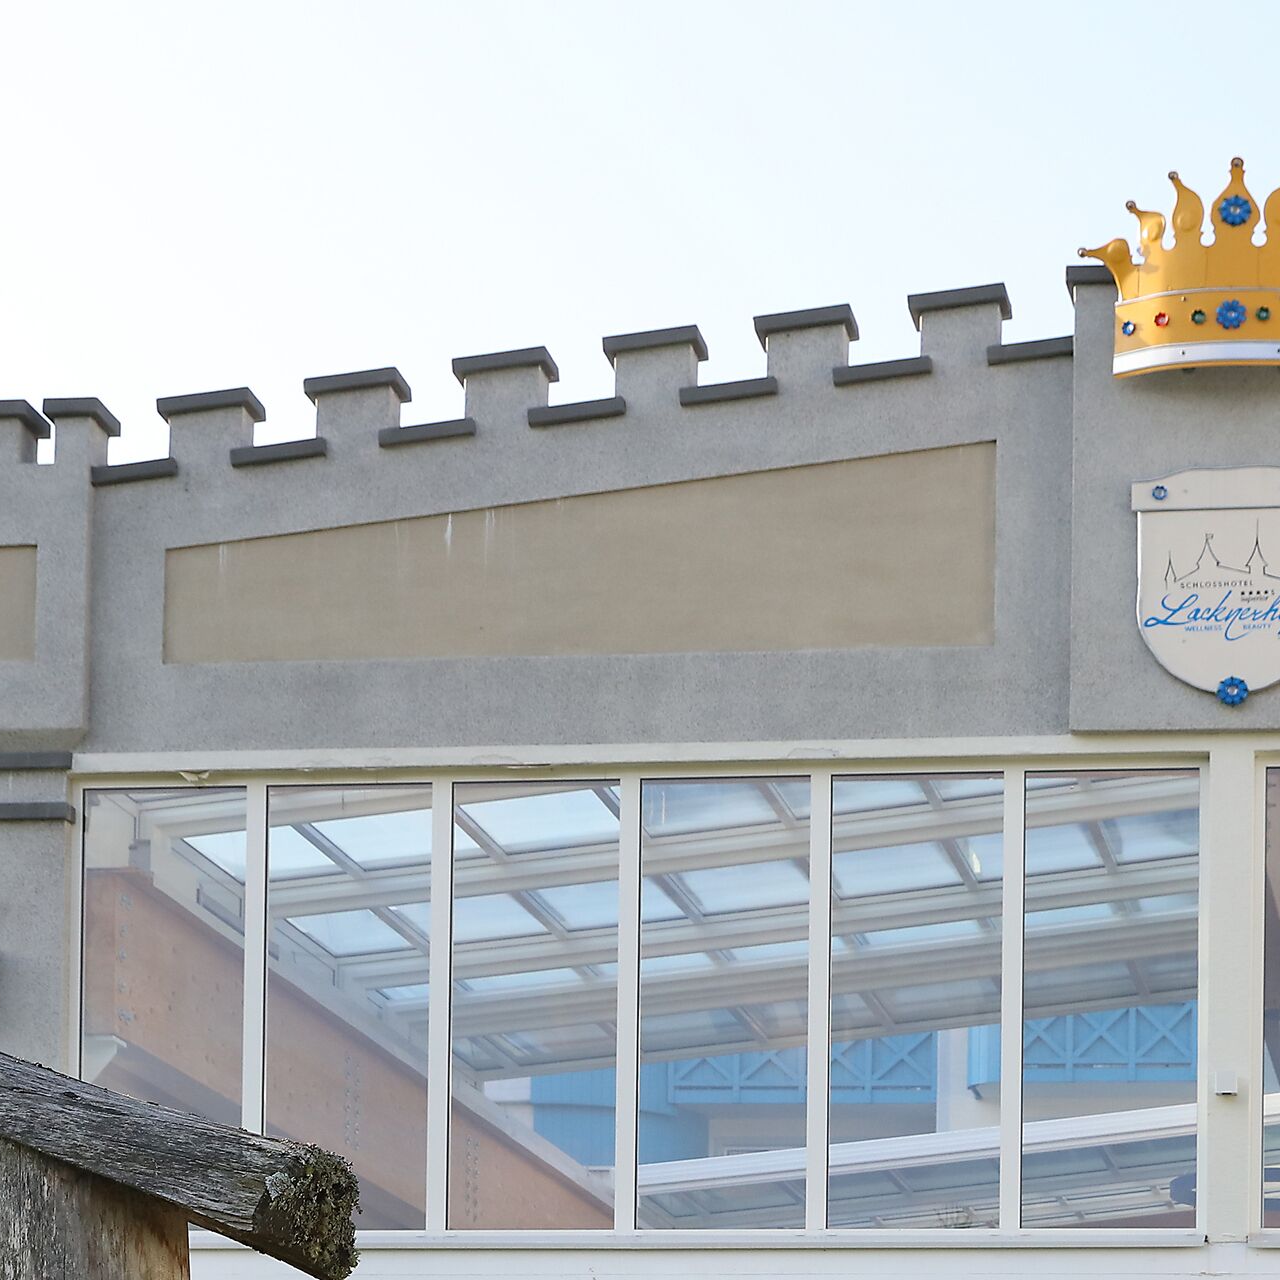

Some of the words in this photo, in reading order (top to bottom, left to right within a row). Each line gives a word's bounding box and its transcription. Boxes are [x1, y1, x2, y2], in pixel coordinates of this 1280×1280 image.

[1180, 580, 1254, 589] SCHLOSSHOTEL
[1184, 624, 1223, 632] WELLNESS
[1243, 623, 1272, 631] BEAUTY
